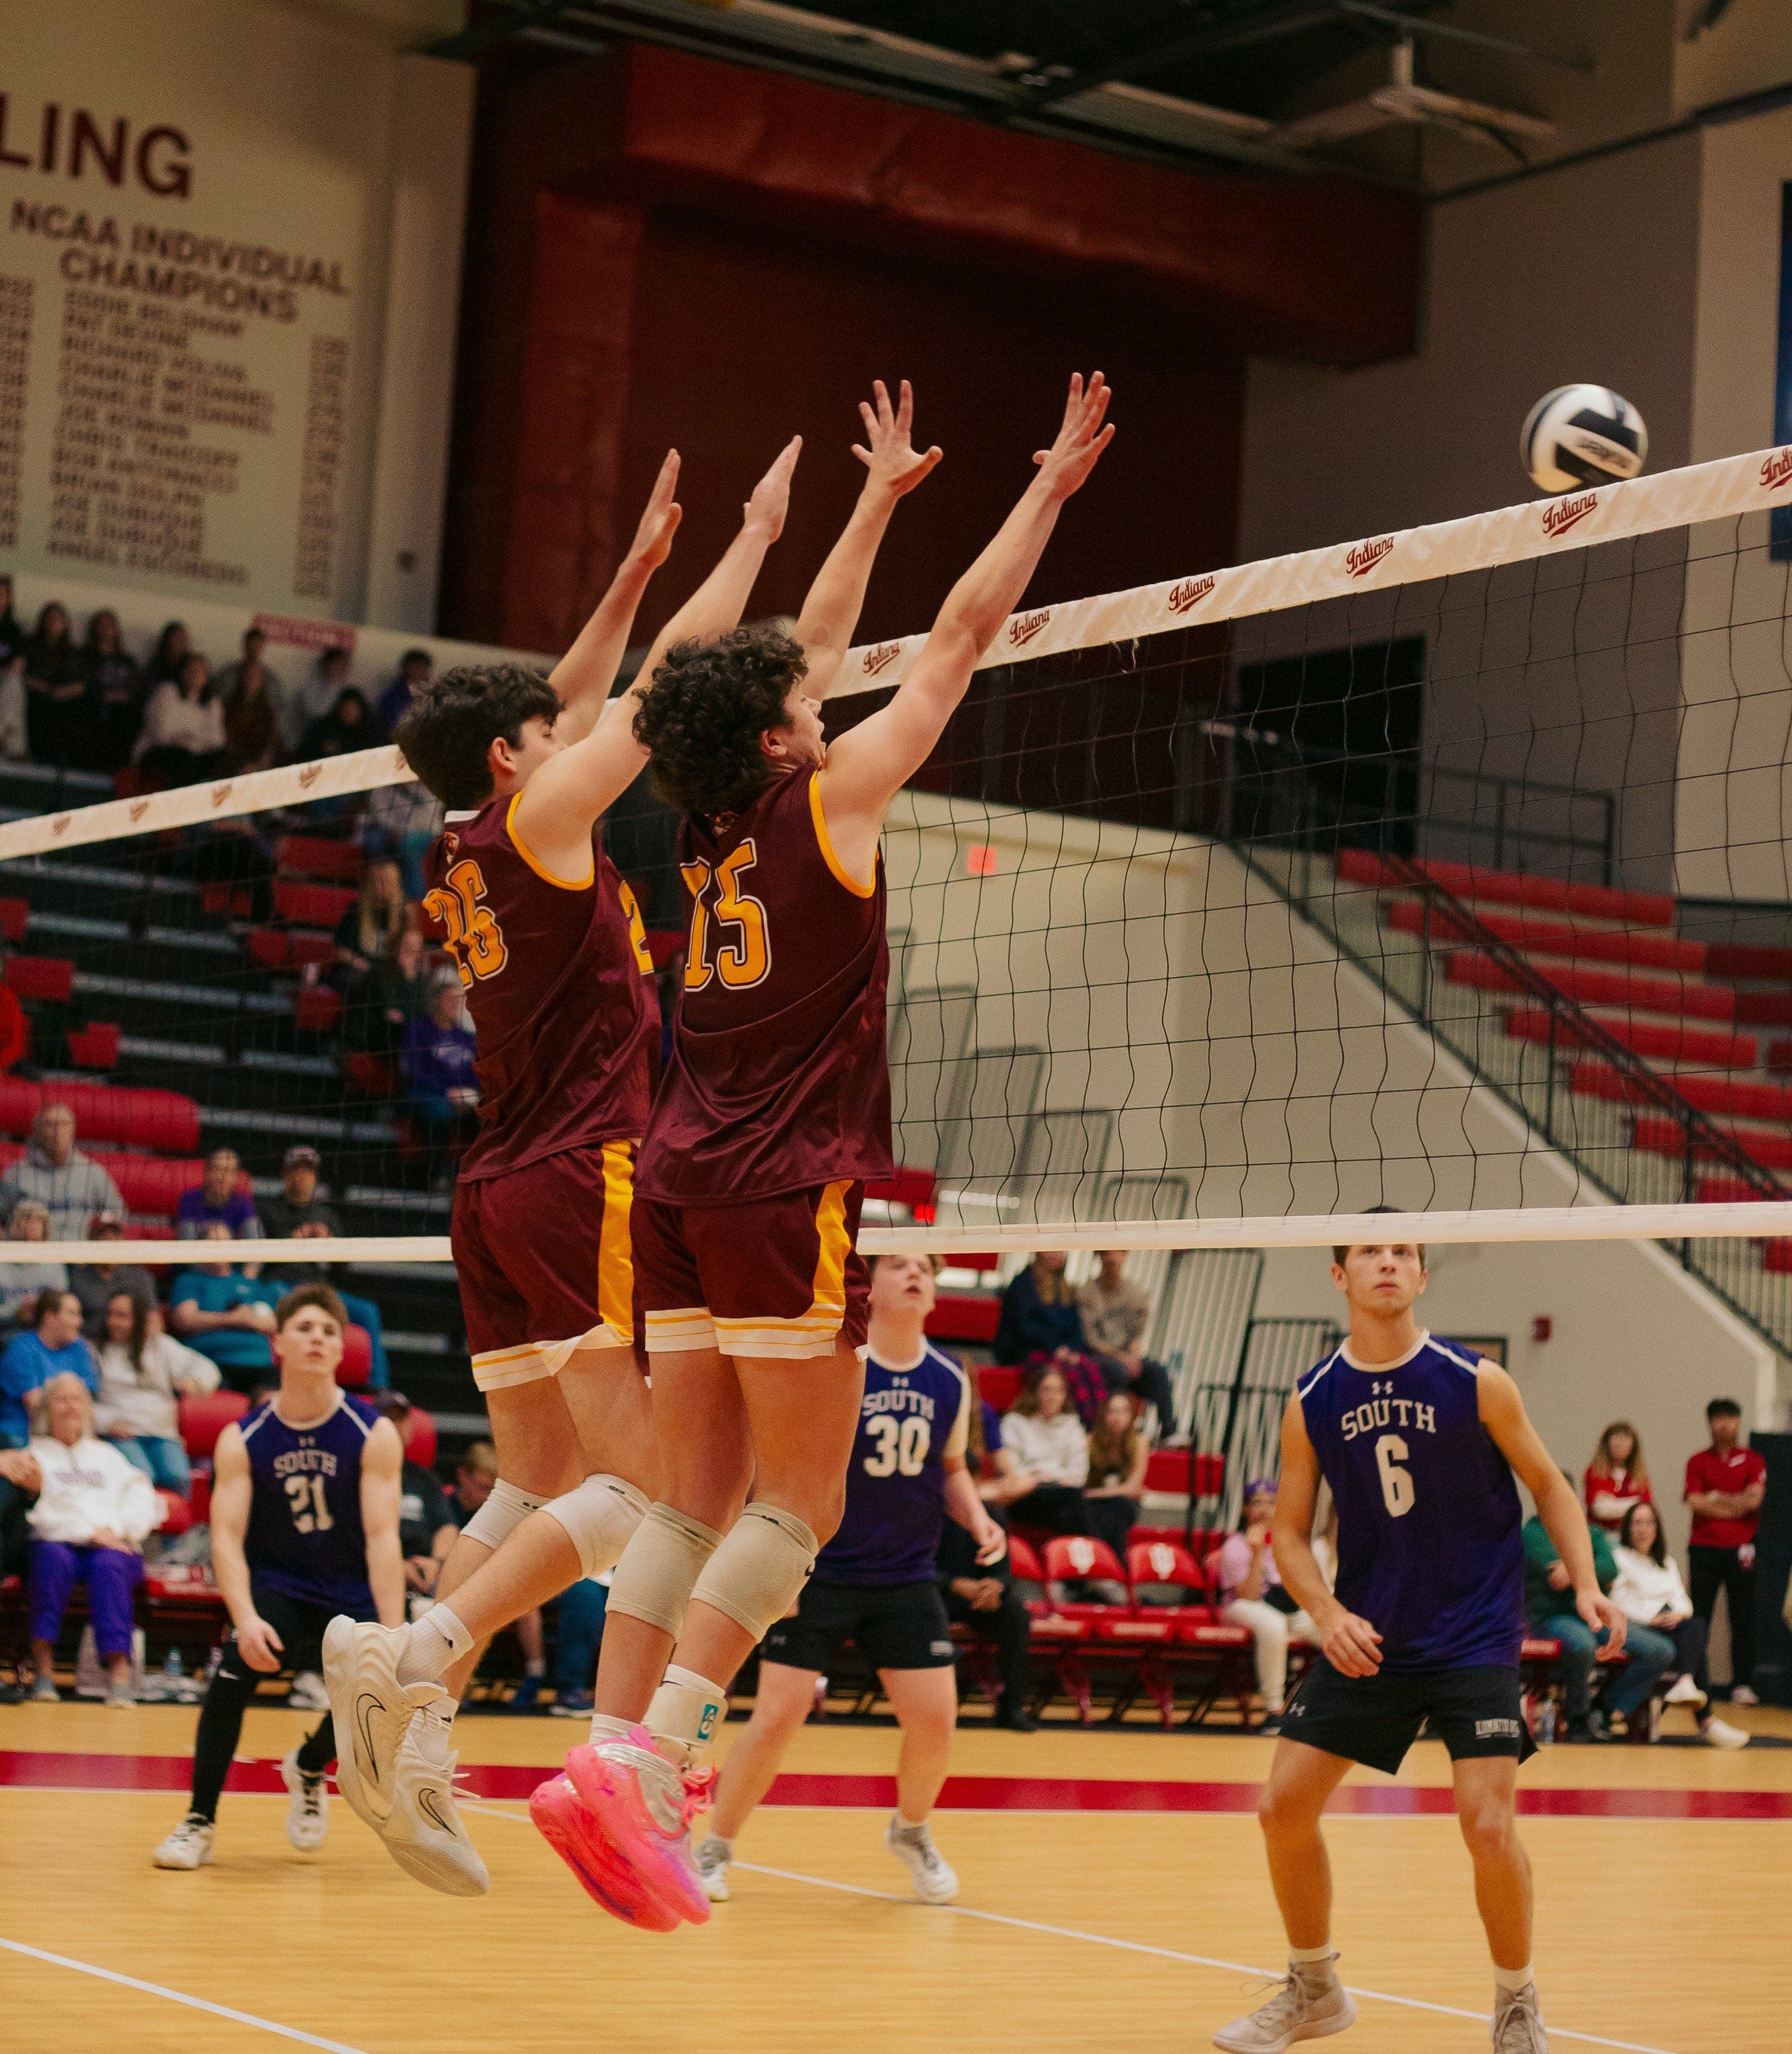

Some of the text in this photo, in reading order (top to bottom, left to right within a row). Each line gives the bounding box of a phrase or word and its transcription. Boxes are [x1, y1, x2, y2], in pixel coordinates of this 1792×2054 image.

[11, 200, 352, 297] NCAA INDIVIDUAL
[61, 248, 299, 323] CHAMPIONS
[1543, 493, 1598, 539] Indiana
[1346, 535, 1394, 579] Indiana
[1168, 575, 1215, 615] Indiana
[1009, 609, 1050, 648] Indiana
[423, 859, 508, 990] 26
[680, 837, 771, 991] 15
[861, 1389, 935, 1421] SOUTH
[1341, 1399, 1436, 1441] SOUTH
[273, 1449, 338, 1479] SOUTH
[863, 1414, 930, 1478] 30
[1375, 1434, 1415, 1517] 6
[284, 1475, 334, 1534] 21
